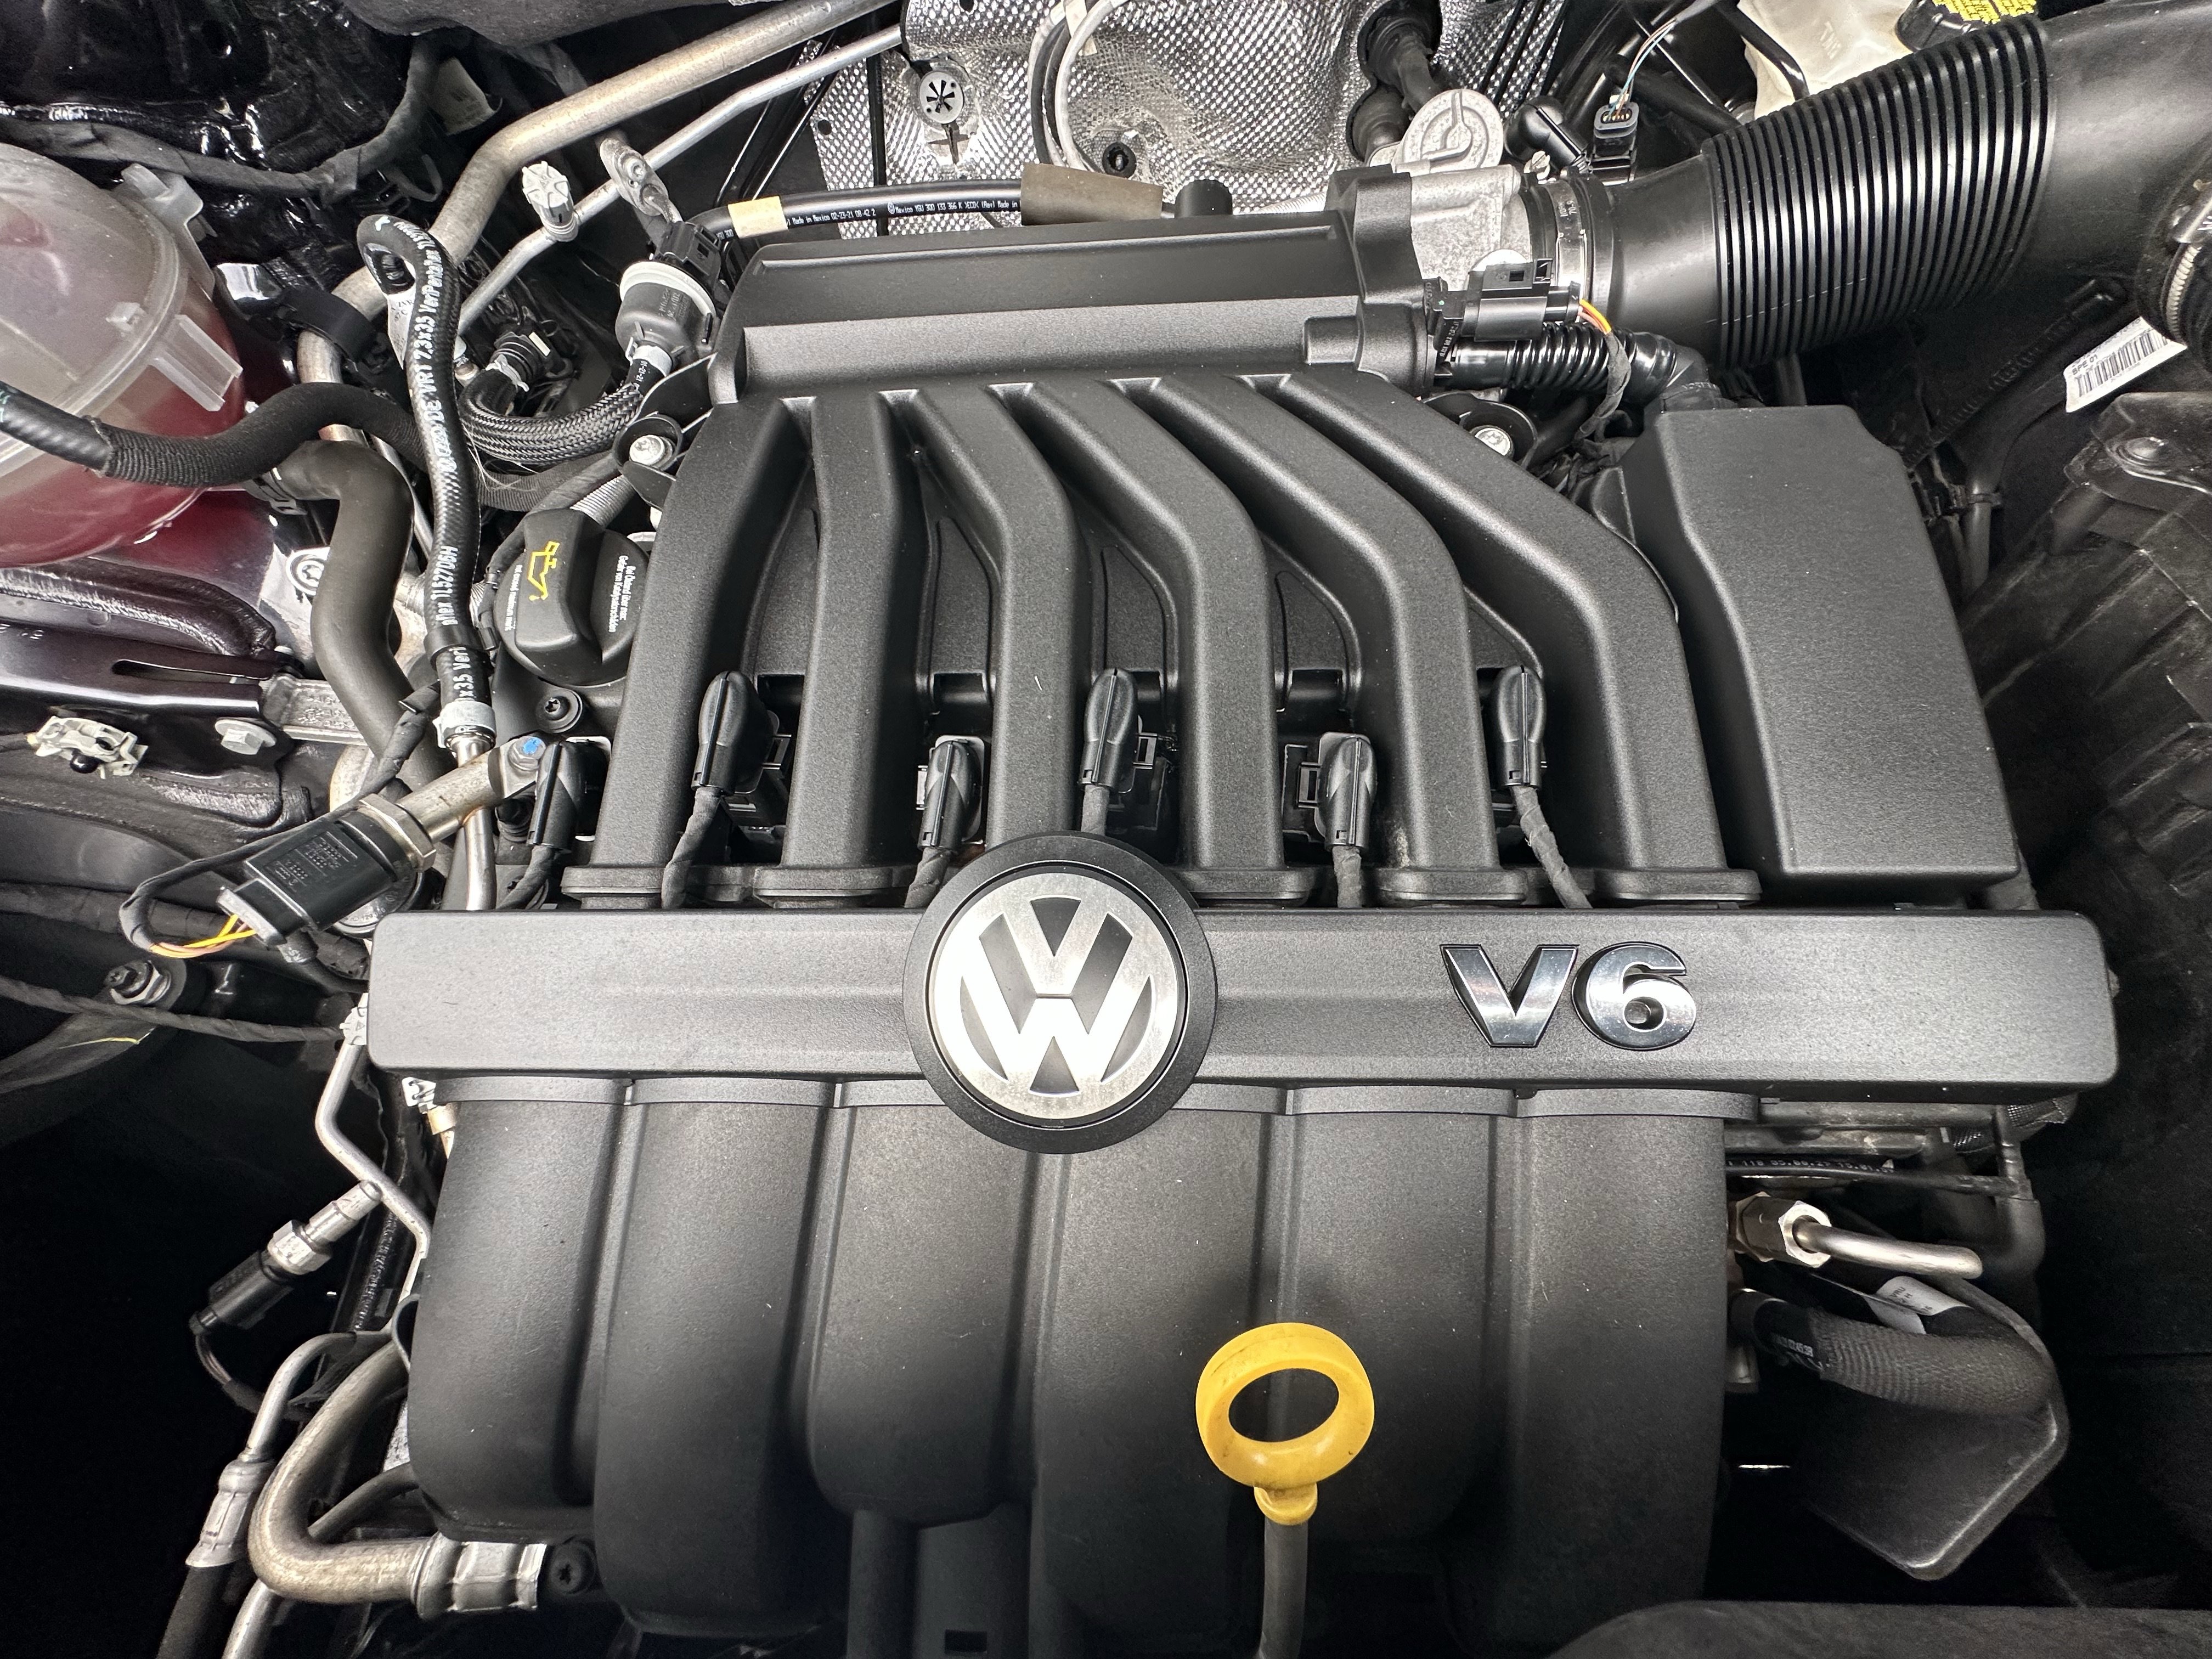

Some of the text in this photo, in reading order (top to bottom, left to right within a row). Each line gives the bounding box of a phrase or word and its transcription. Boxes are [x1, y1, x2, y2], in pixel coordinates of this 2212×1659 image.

[937, 202, 946, 211] 133
[997, 200, 1009, 208] Made
[793, 216, 804, 224] Made
[813, 213, 830, 223] Mexico
[1440, 941, 1697, 1051] V6
